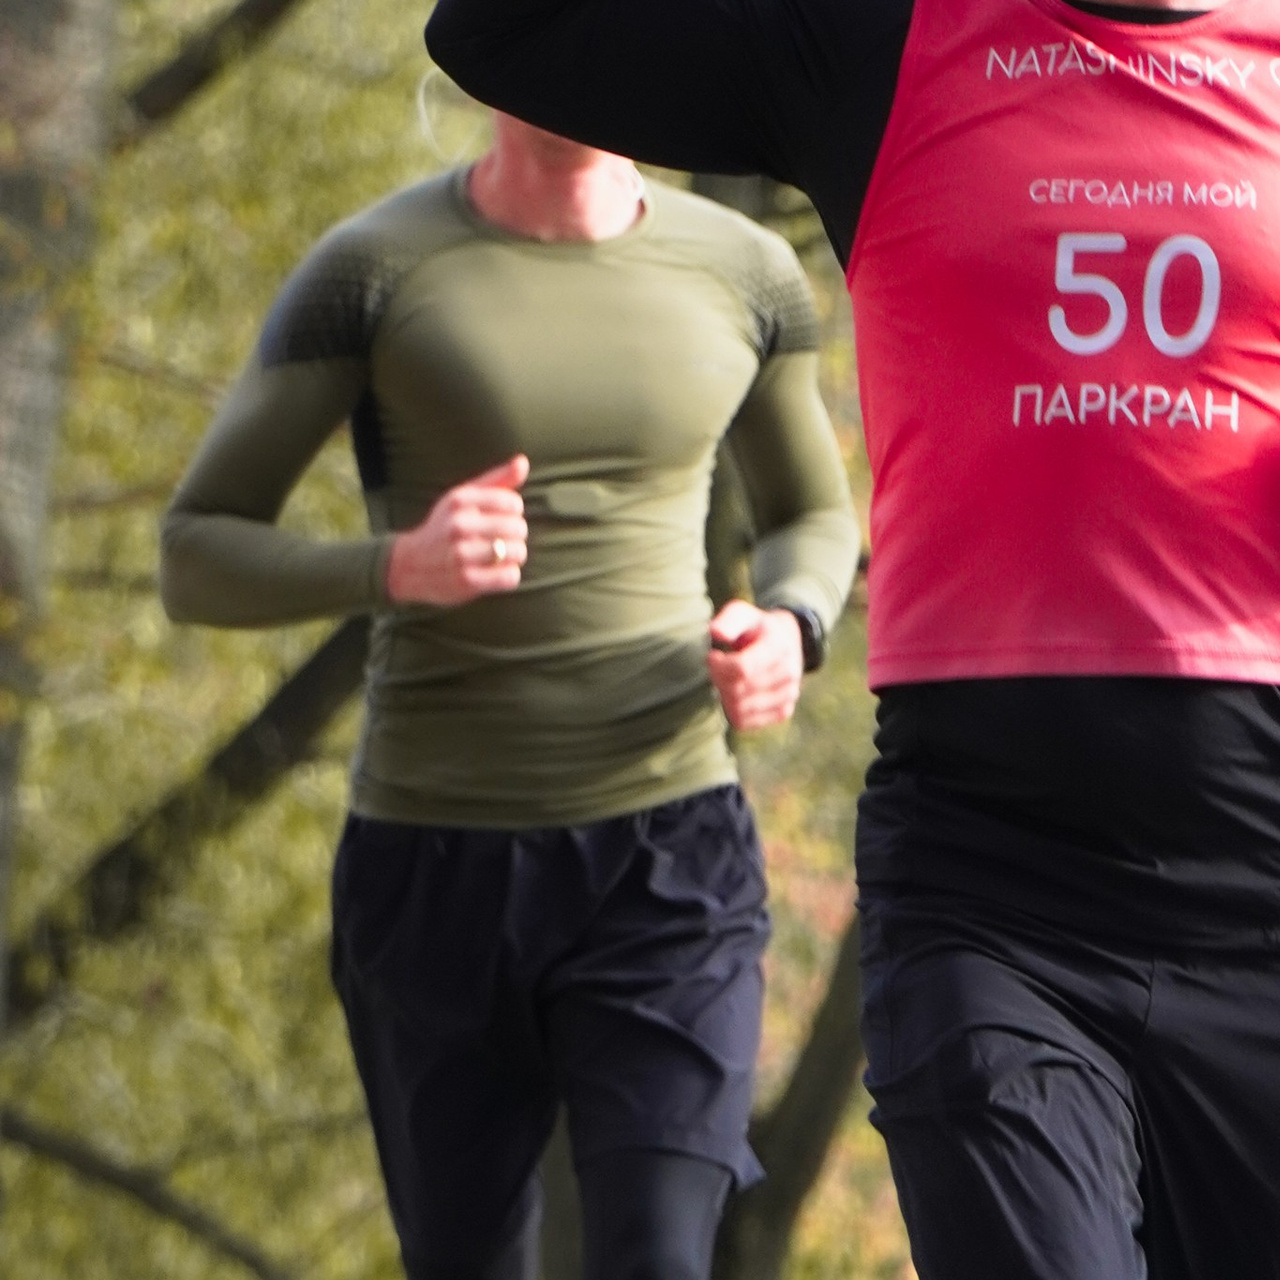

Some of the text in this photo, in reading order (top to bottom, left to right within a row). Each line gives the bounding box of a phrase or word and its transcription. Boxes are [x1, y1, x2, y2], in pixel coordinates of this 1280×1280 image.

[1028, 178, 1258, 211] СЕГОДНЯ МОЙ
[1047, 231, 1222, 359] 50
[1012, 382, 1241, 433] ПАРКРАН
